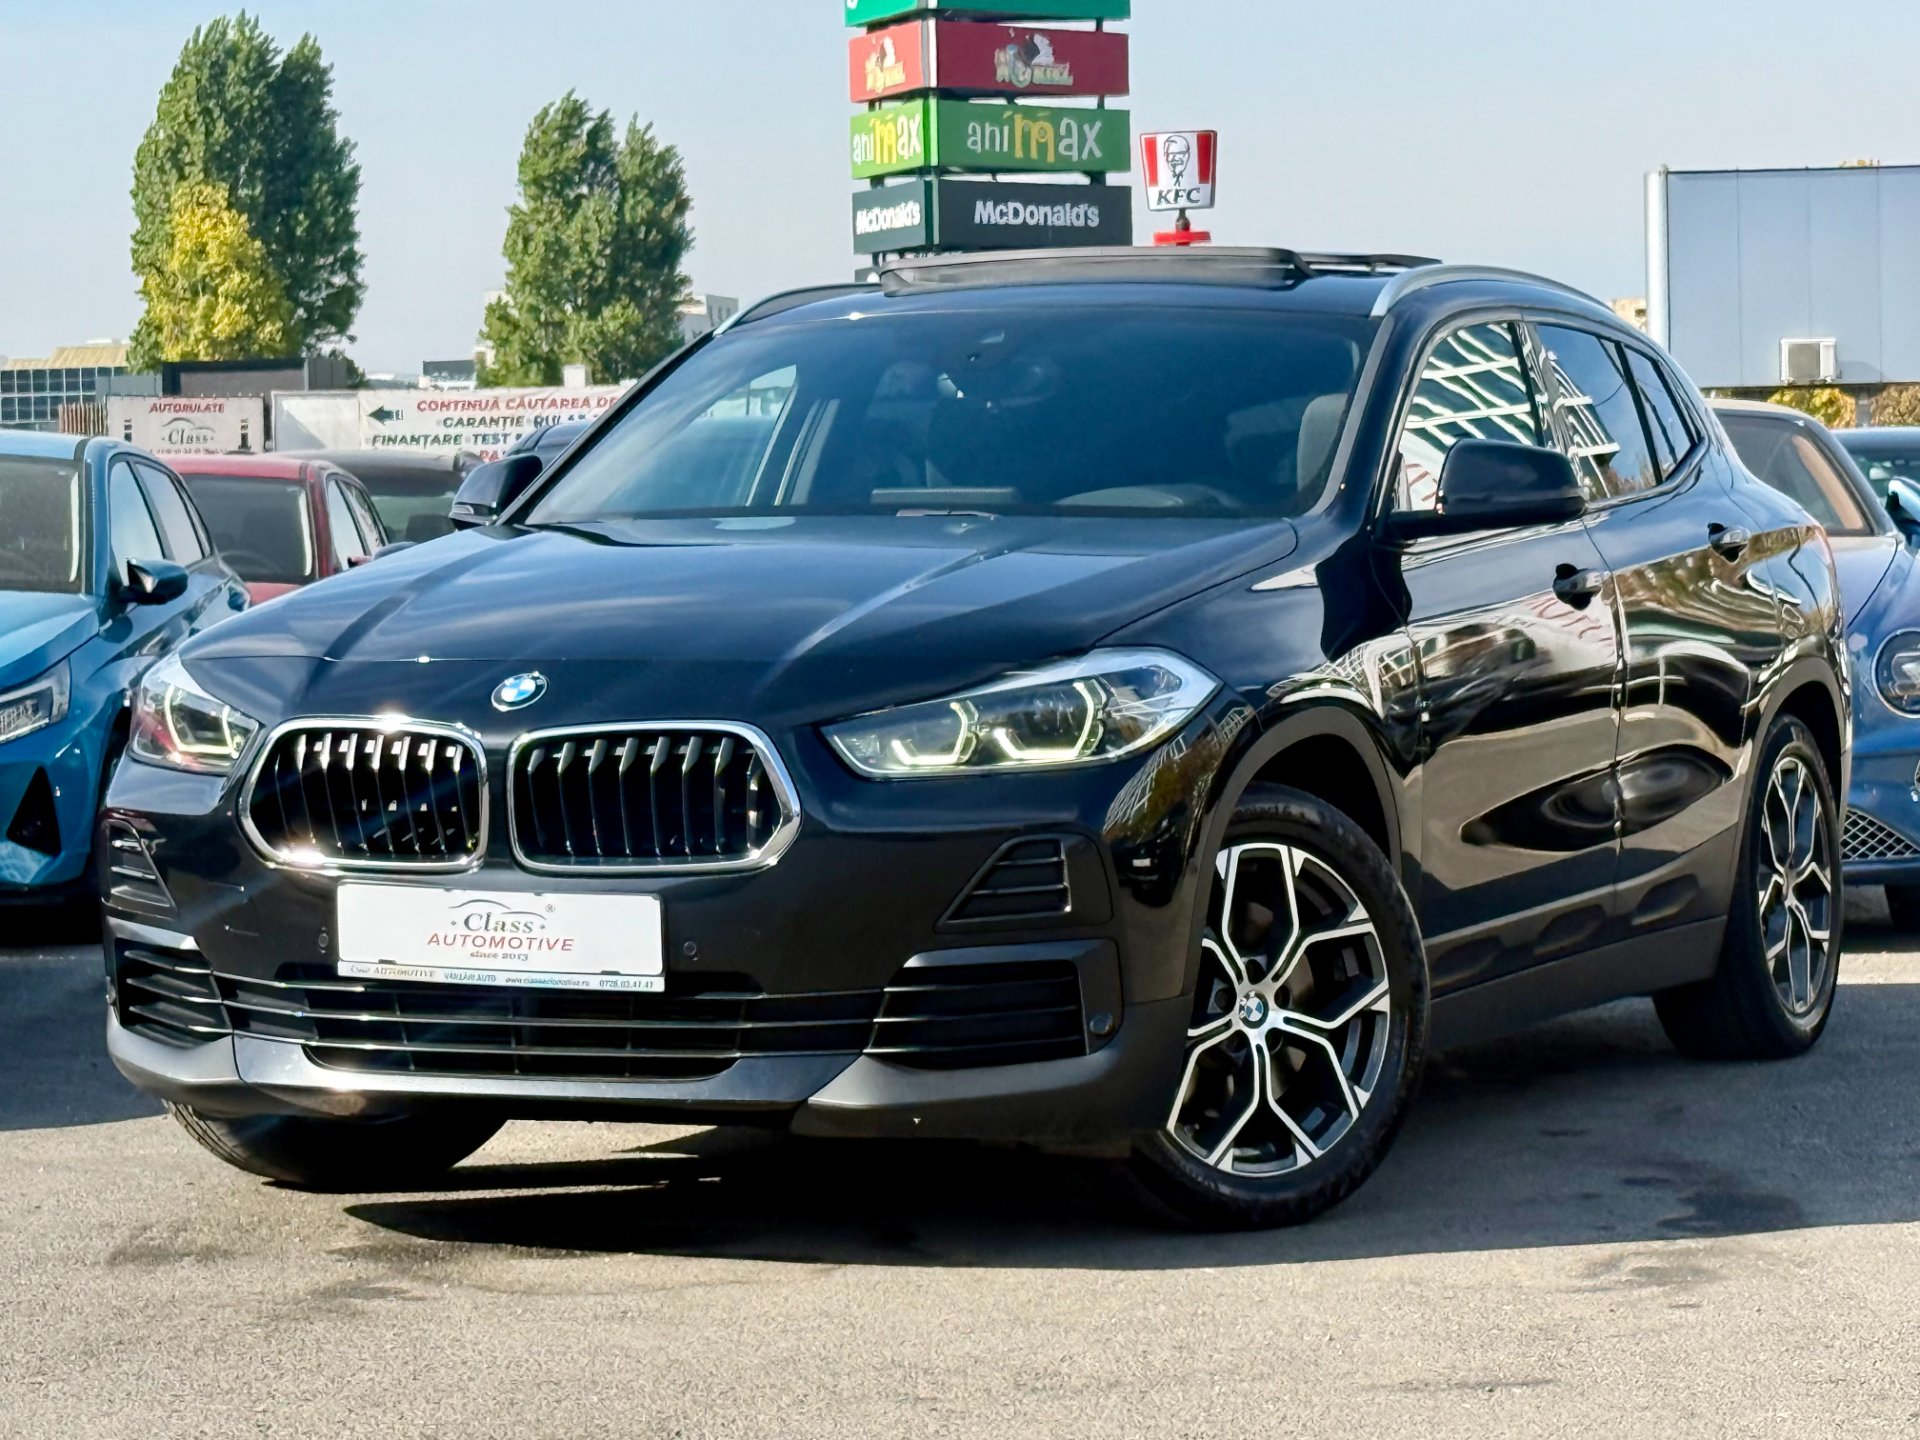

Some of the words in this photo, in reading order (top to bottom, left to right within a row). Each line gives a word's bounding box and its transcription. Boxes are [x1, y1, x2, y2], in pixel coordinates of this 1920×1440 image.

[853, 113, 922, 165] animax
[966, 110, 1103, 163] animax
[1157, 187, 1201, 206] KFC
[856, 200, 921, 235] McDonald's
[974, 199, 1100, 228] McDonald's
[472, 432, 511, 446] TEST
[463, 912, 534, 934] Class
[427, 932, 575, 952] AUTOMOTIVE
